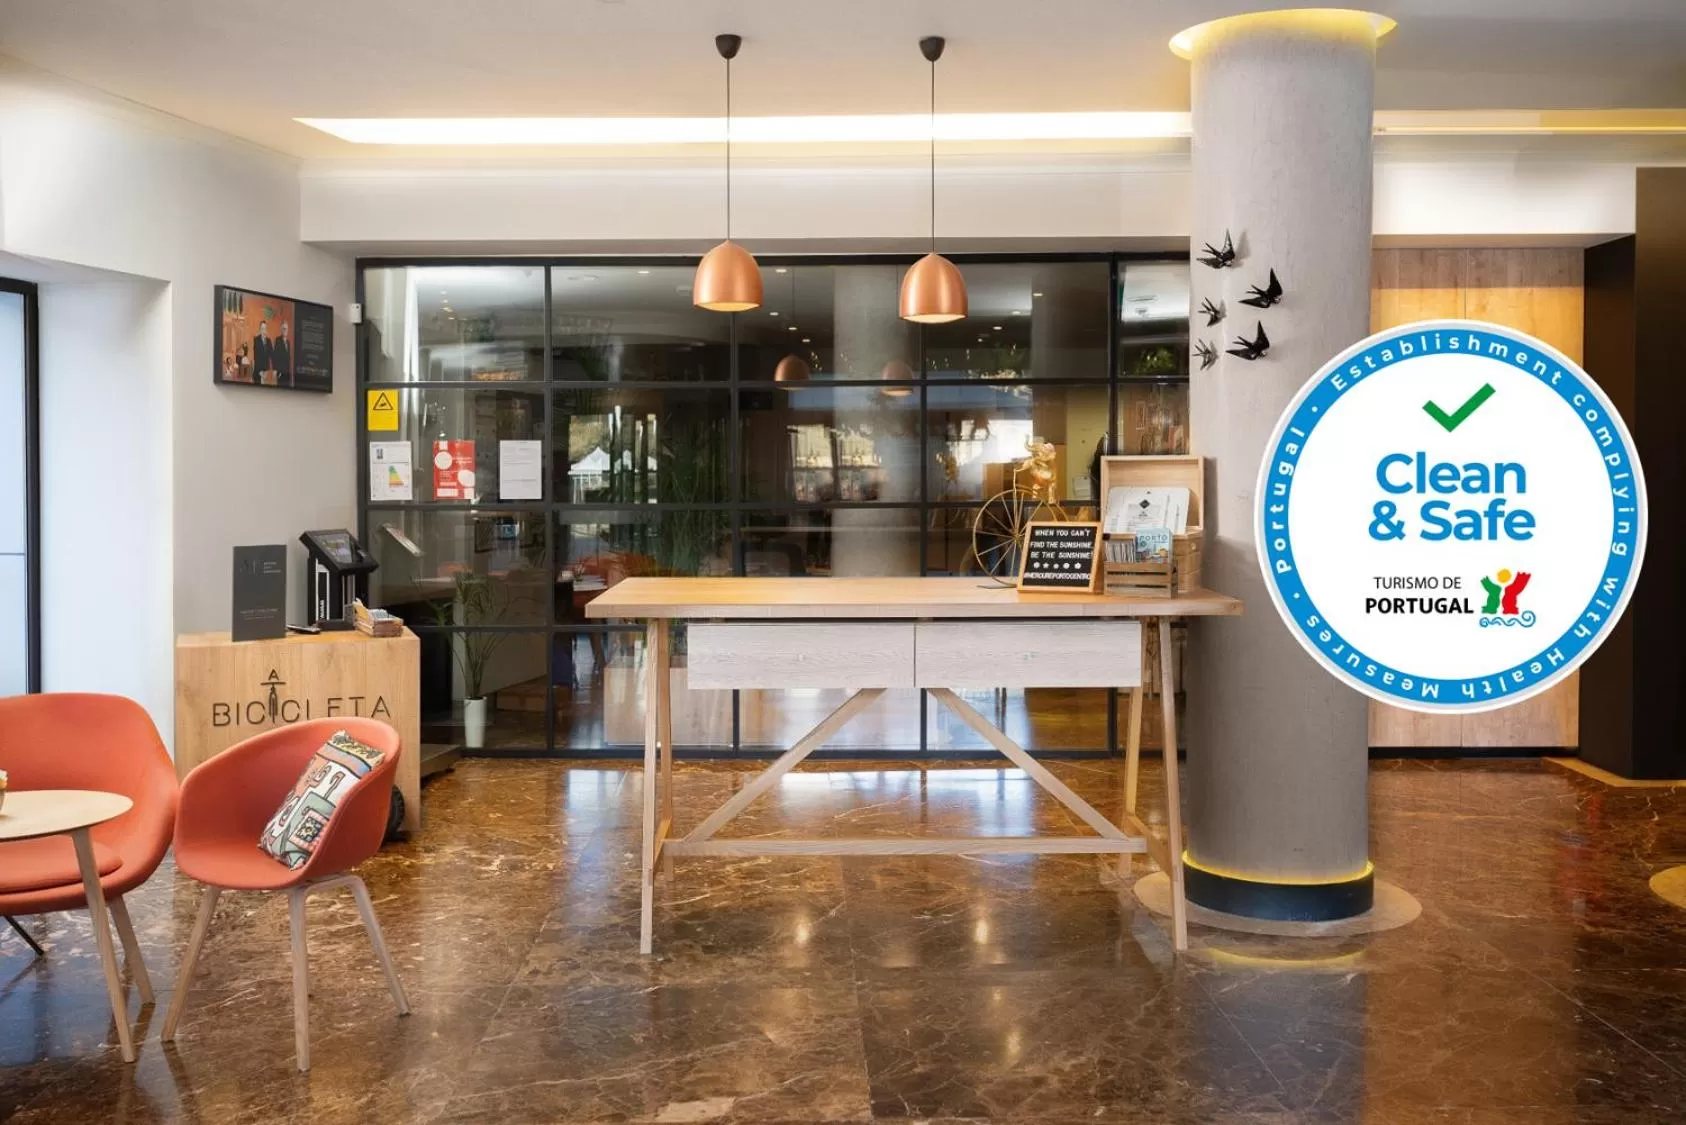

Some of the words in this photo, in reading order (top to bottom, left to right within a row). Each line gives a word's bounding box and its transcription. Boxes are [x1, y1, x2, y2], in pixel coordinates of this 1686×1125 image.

[1030, 551, 1039, 559] BE
[1041, 551, 1056, 559] THE
[268, 669, 280, 681] A
